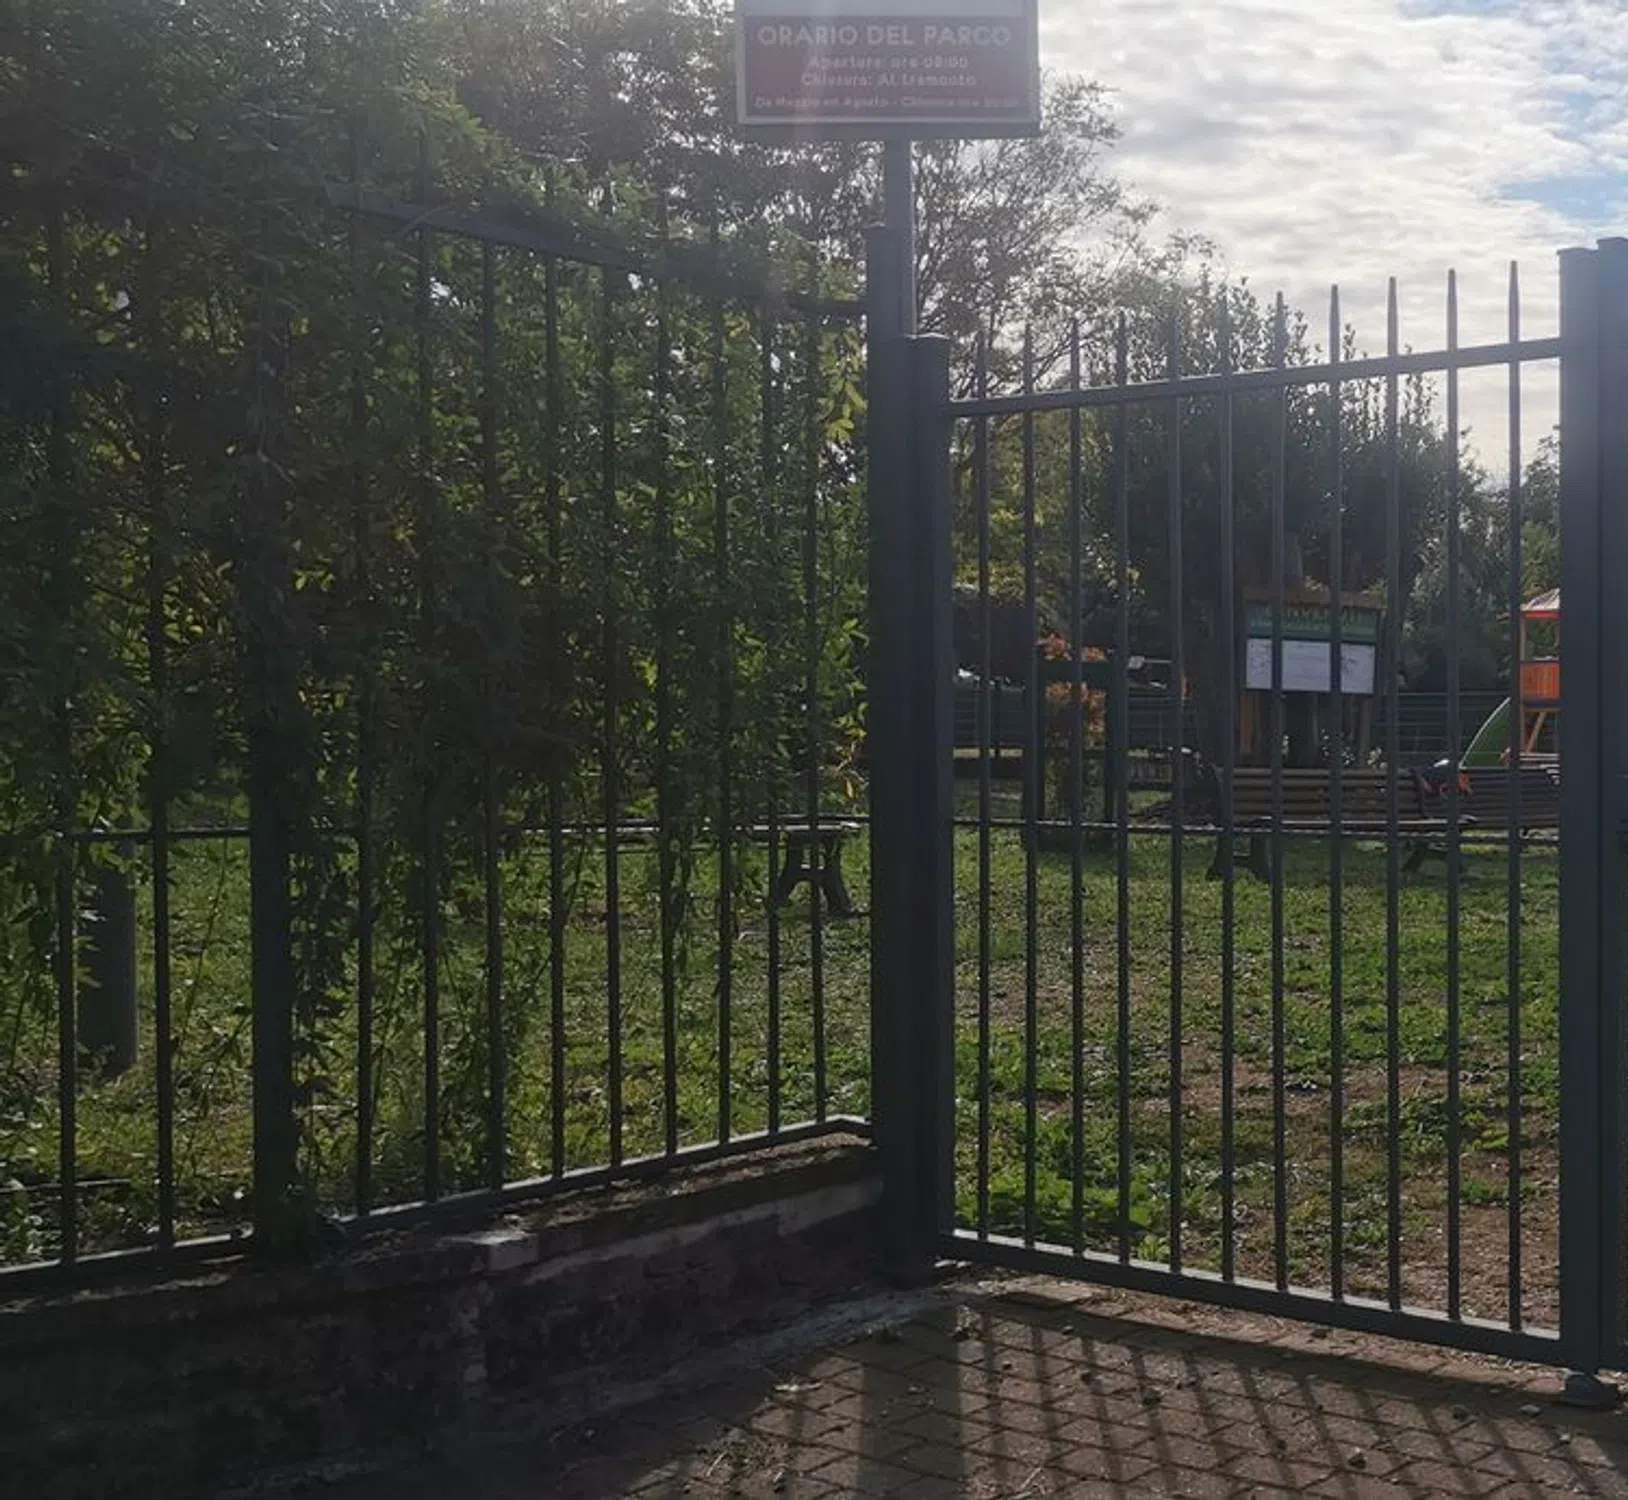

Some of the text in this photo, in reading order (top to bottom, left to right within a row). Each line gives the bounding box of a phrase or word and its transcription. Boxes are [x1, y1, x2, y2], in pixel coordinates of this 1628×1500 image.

[756, 24, 1012, 46] ORARIO DEL PARCO
